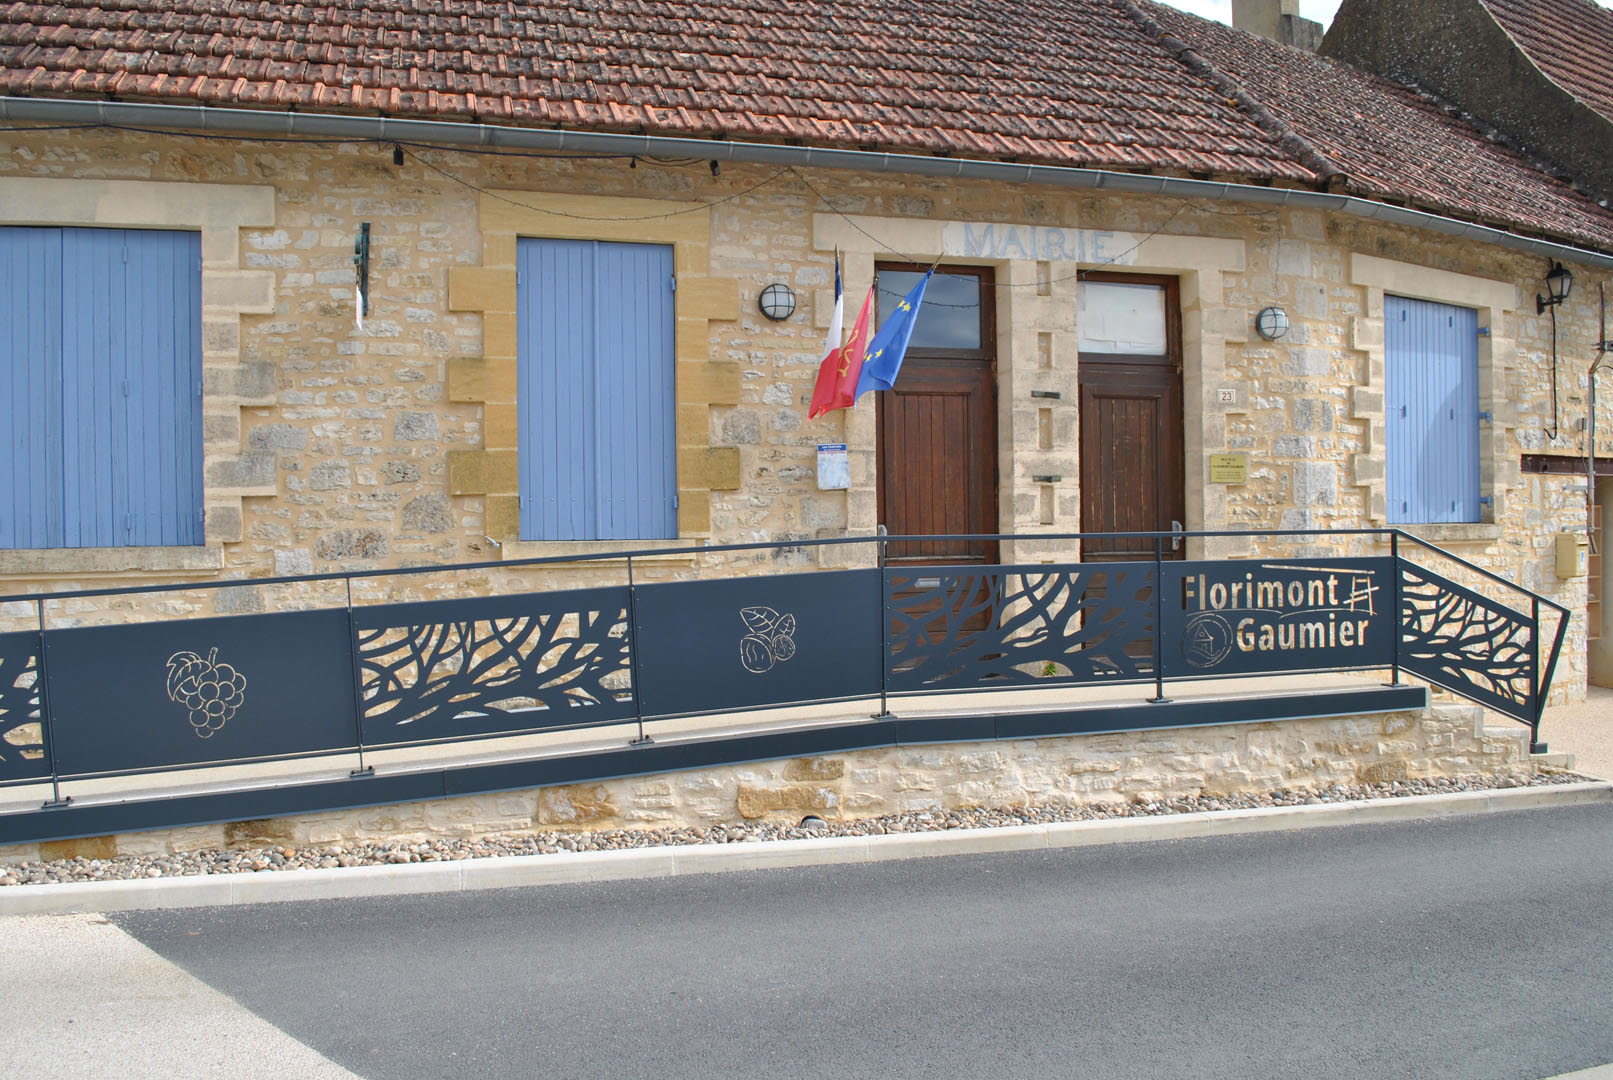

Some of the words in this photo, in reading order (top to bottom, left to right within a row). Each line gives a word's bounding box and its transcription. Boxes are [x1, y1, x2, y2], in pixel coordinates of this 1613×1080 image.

[965, 223, 1114, 262] MAIRIE
[1221, 391, 1232, 401] 23
[1181, 573, 1339, 610] Florimont
[1236, 613, 1369, 652] Gaumier
